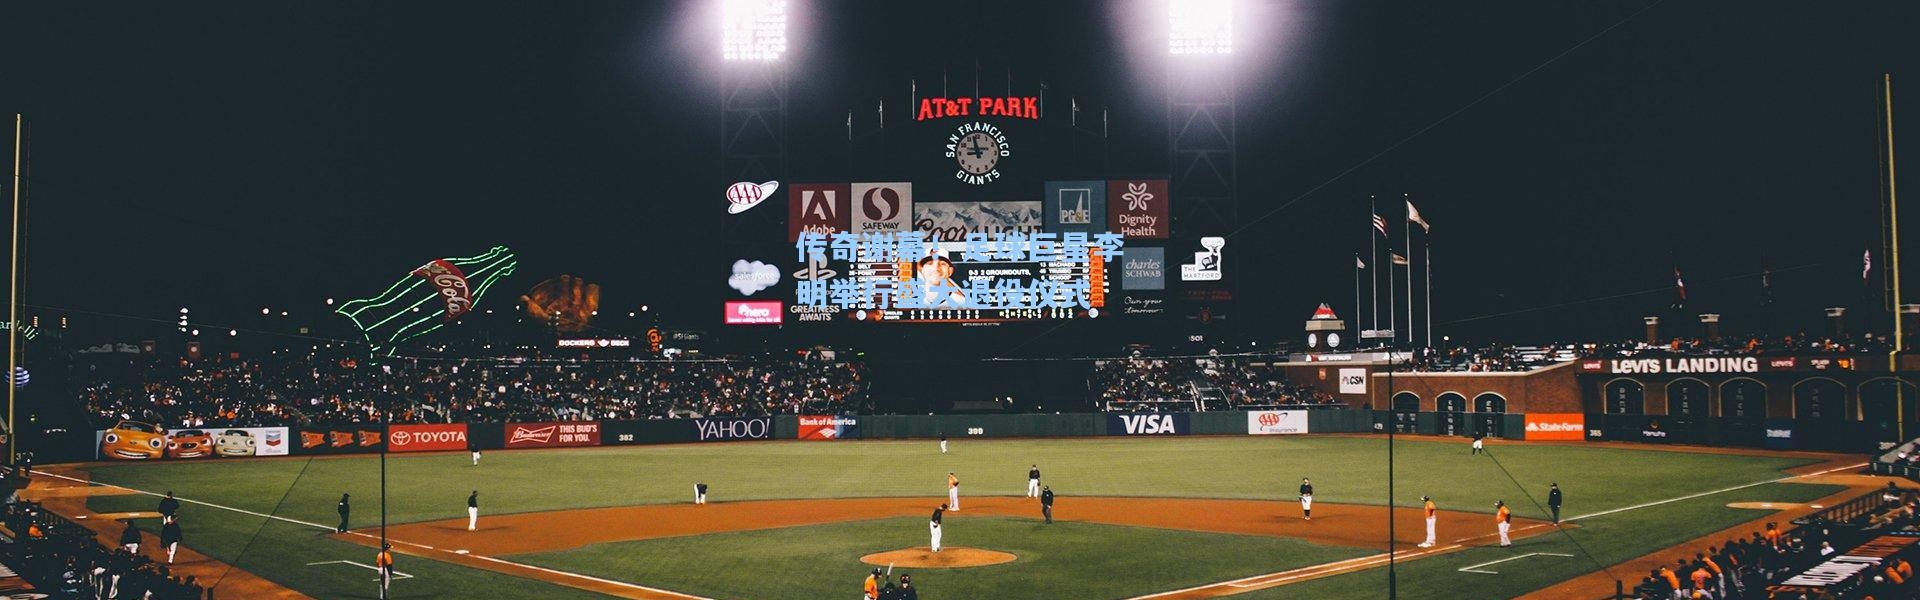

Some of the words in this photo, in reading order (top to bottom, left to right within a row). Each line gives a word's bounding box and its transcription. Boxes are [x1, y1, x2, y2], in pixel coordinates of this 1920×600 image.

[917, 97, 972, 121] AT&T
[978, 97, 1038, 120] PARK
[946, 134, 960, 157] SAN
[958, 122, 1010, 157] FRANCISCO
[956, 169, 1000, 185] GIANTS
[1061, 209, 1089, 222] PG&E
[1119, 214, 1157, 227] Dignity
[803, 224, 836, 235] Adobe
[862, 222, 900, 230] SAFEWAY
[917, 218, 970, 242] Coor
[1121, 226, 1156, 236] Health
[1125, 258, 1161, 270] charles
[1125, 269, 1162, 278] SCHWAB
[434, 275, 471, 317] Cola
[790, 304, 840, 314] GREATNESS
[799, 312, 832, 321] AWAITS
[1665, 357, 1758, 373] LANDING
[1350, 375, 1364, 385] CSN
[800, 418, 819, 426] Bank
[827, 418, 857, 426] America
[1118, 415, 1176, 435] VISA
[559, 424, 576, 434] THIS
[577, 424, 598, 433] BUD'S
[695, 418, 771, 441] YAHOO!
[413, 431, 467, 443] TOYOTA
[559, 434, 573, 443] FOR
[574, 433, 590, 442] YOU.
